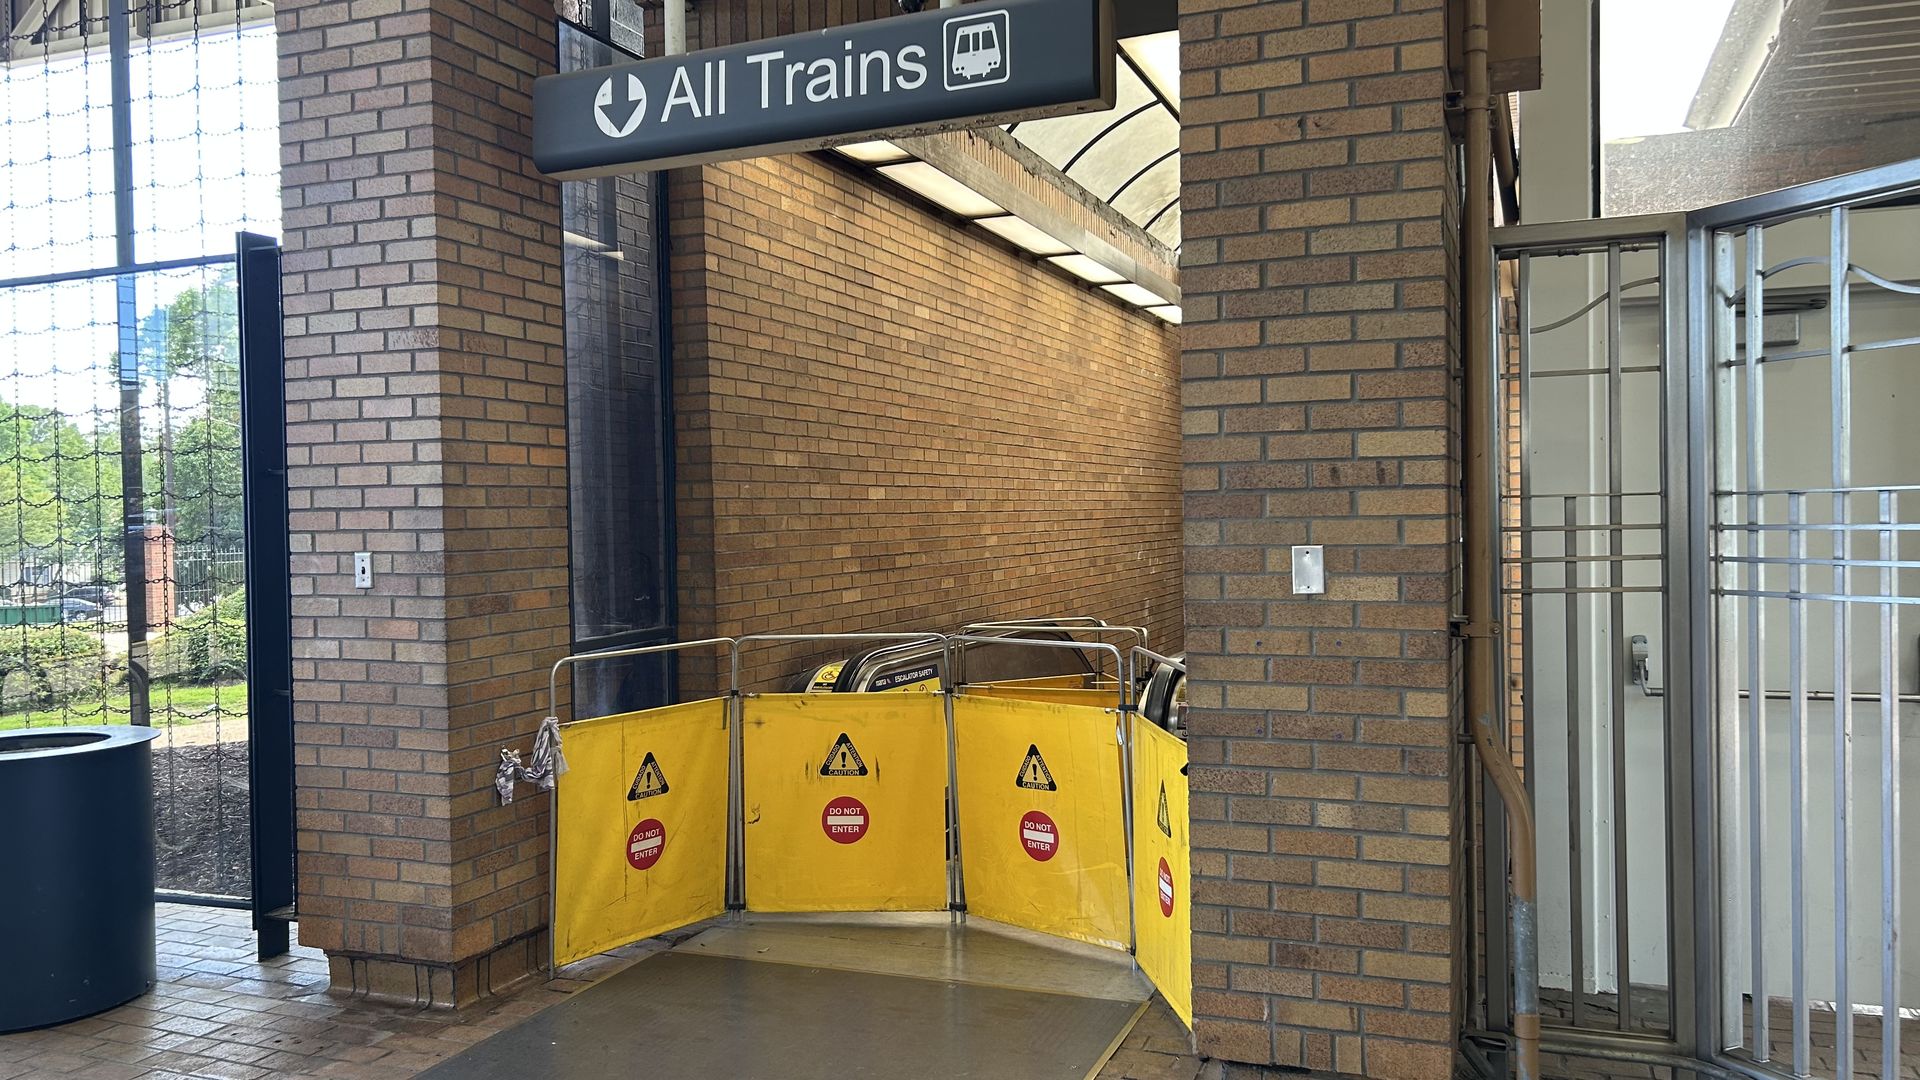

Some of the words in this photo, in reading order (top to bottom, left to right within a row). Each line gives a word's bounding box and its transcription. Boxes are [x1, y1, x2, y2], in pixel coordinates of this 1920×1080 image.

[661, 59, 726, 122] All
[746, 39, 928, 109] Trains
[894, 671, 919, 683] ESCALATOR
[918, 668, 933, 677] SAFETY
[825, 744, 840, 766] CUIDADO
[846, 742, 863, 768] ATTENTION
[1019, 755, 1031, 777] CUIDADO
[1036, 755, 1052, 782] ATTENTION
[632, 765, 646, 789] CUIDADO
[1022, 781, 1050, 790] CAUTION
[635, 788, 662, 800] CAUTION
[829, 807, 842, 815] DO
[843, 807, 861, 815] NOT
[831, 825, 860, 833] ENTER
[1024, 820, 1035, 830] DO
[1036, 822, 1051, 832] NOT
[633, 832, 644, 842] DO
[645, 828, 660, 839] NOT
[1027, 840, 1050, 852] ENTER
[634, 847, 658, 860] ENTER
